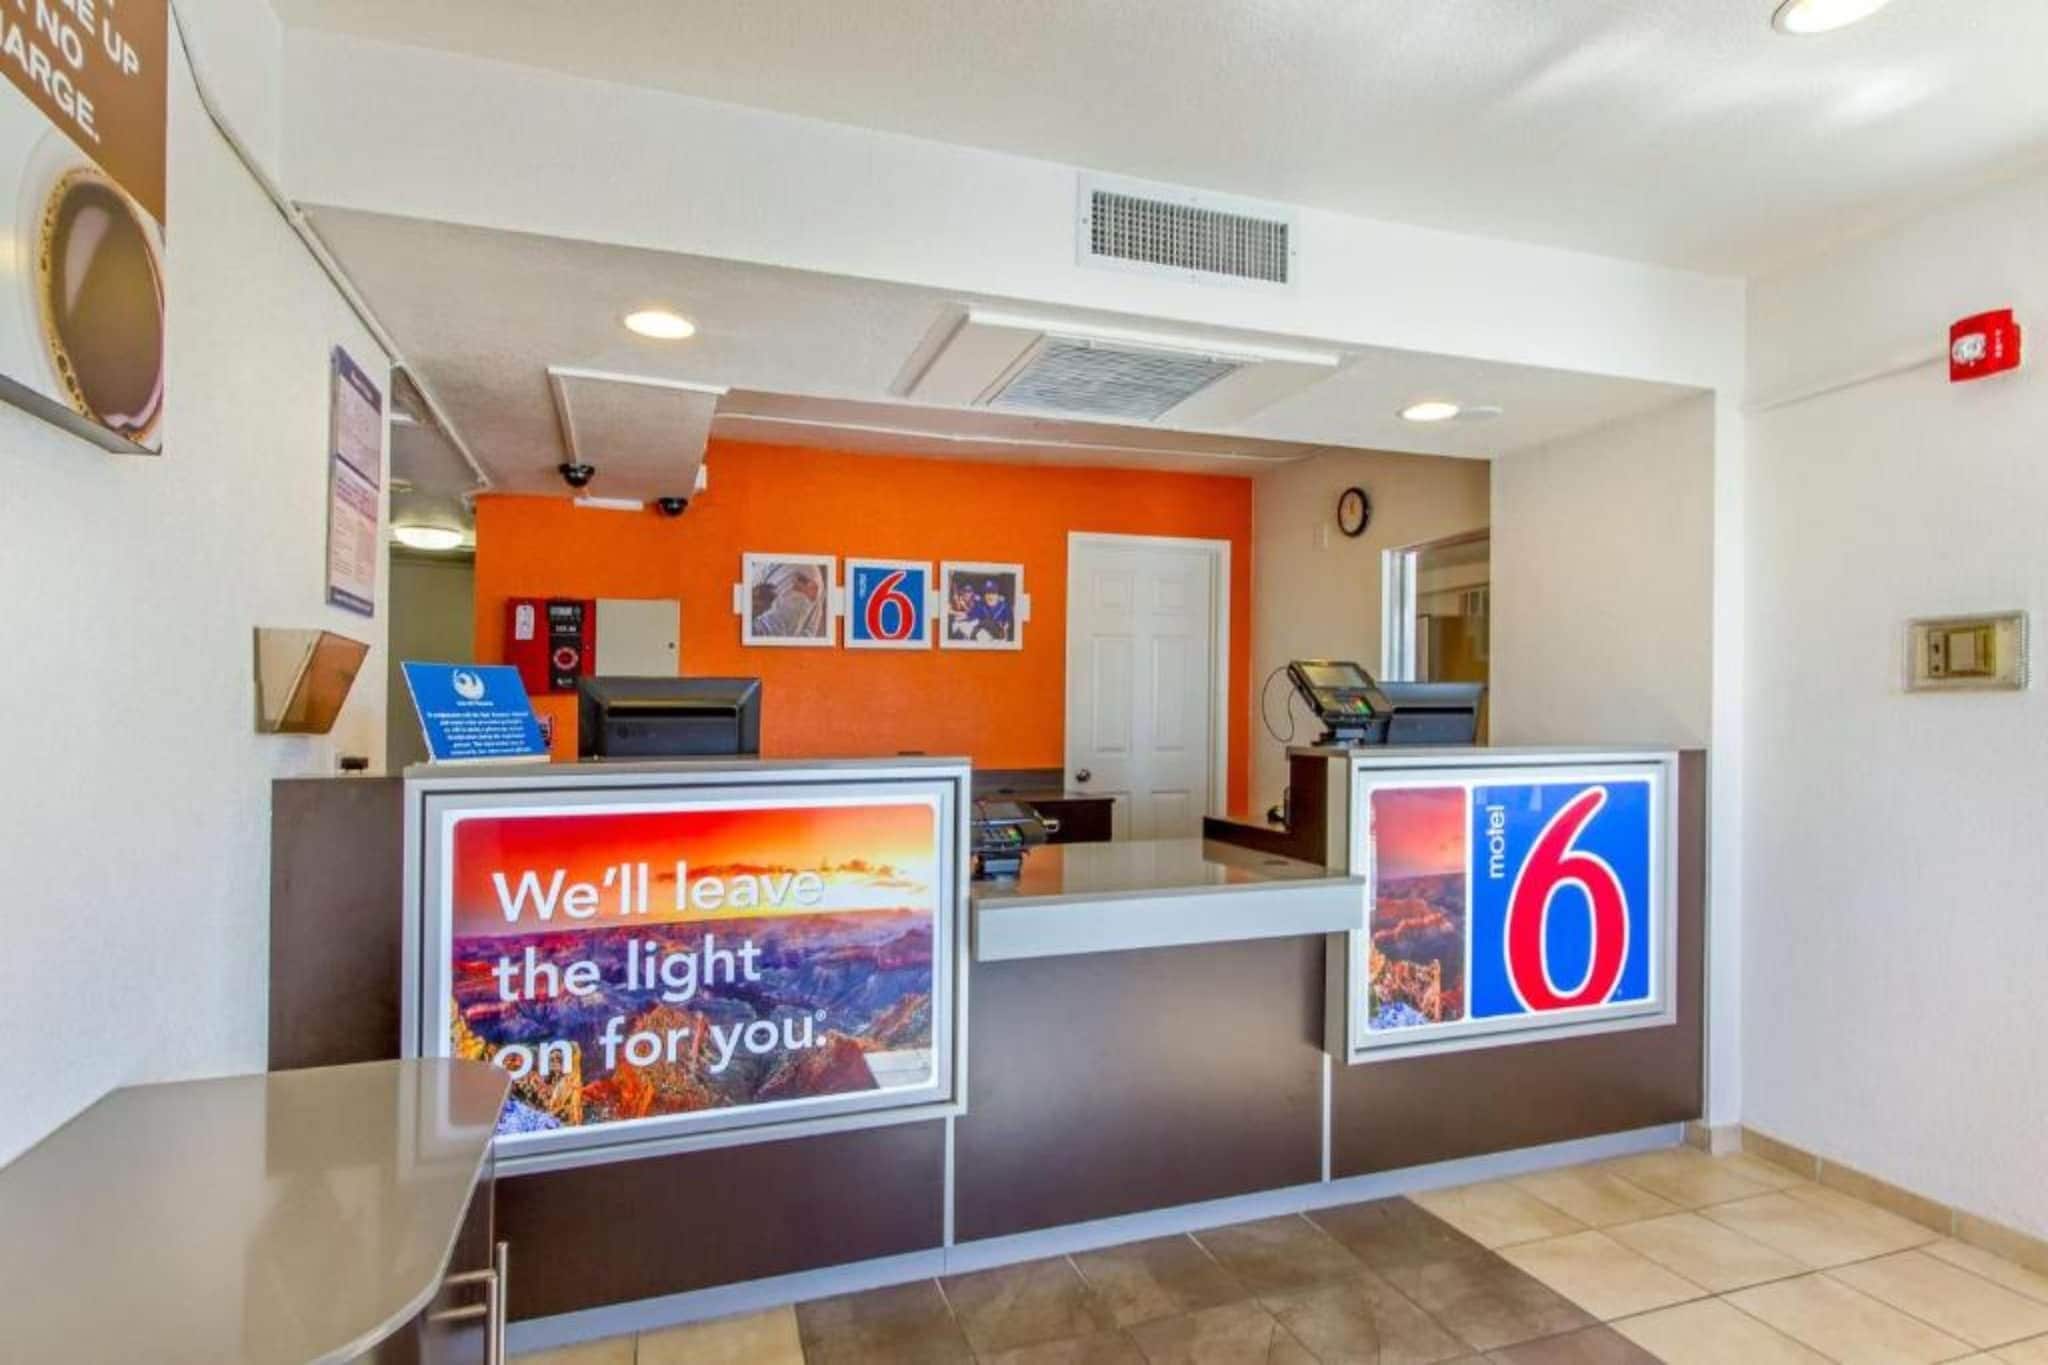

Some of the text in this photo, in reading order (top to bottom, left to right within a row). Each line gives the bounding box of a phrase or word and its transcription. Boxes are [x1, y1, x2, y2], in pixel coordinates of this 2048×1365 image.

[36, 0, 83, 70] NO
[102, 18, 140, 75] UP
[0, 9, 101, 144] ARGE.
[865, 570, 916, 641] 6
[491, 861, 825, 923] We'll leave
[1485, 785, 1630, 1014] motel 6
[491, 934, 762, 1003] the light
[492, 1040, 575, 1080] on
[598, 1016, 690, 1069] for
